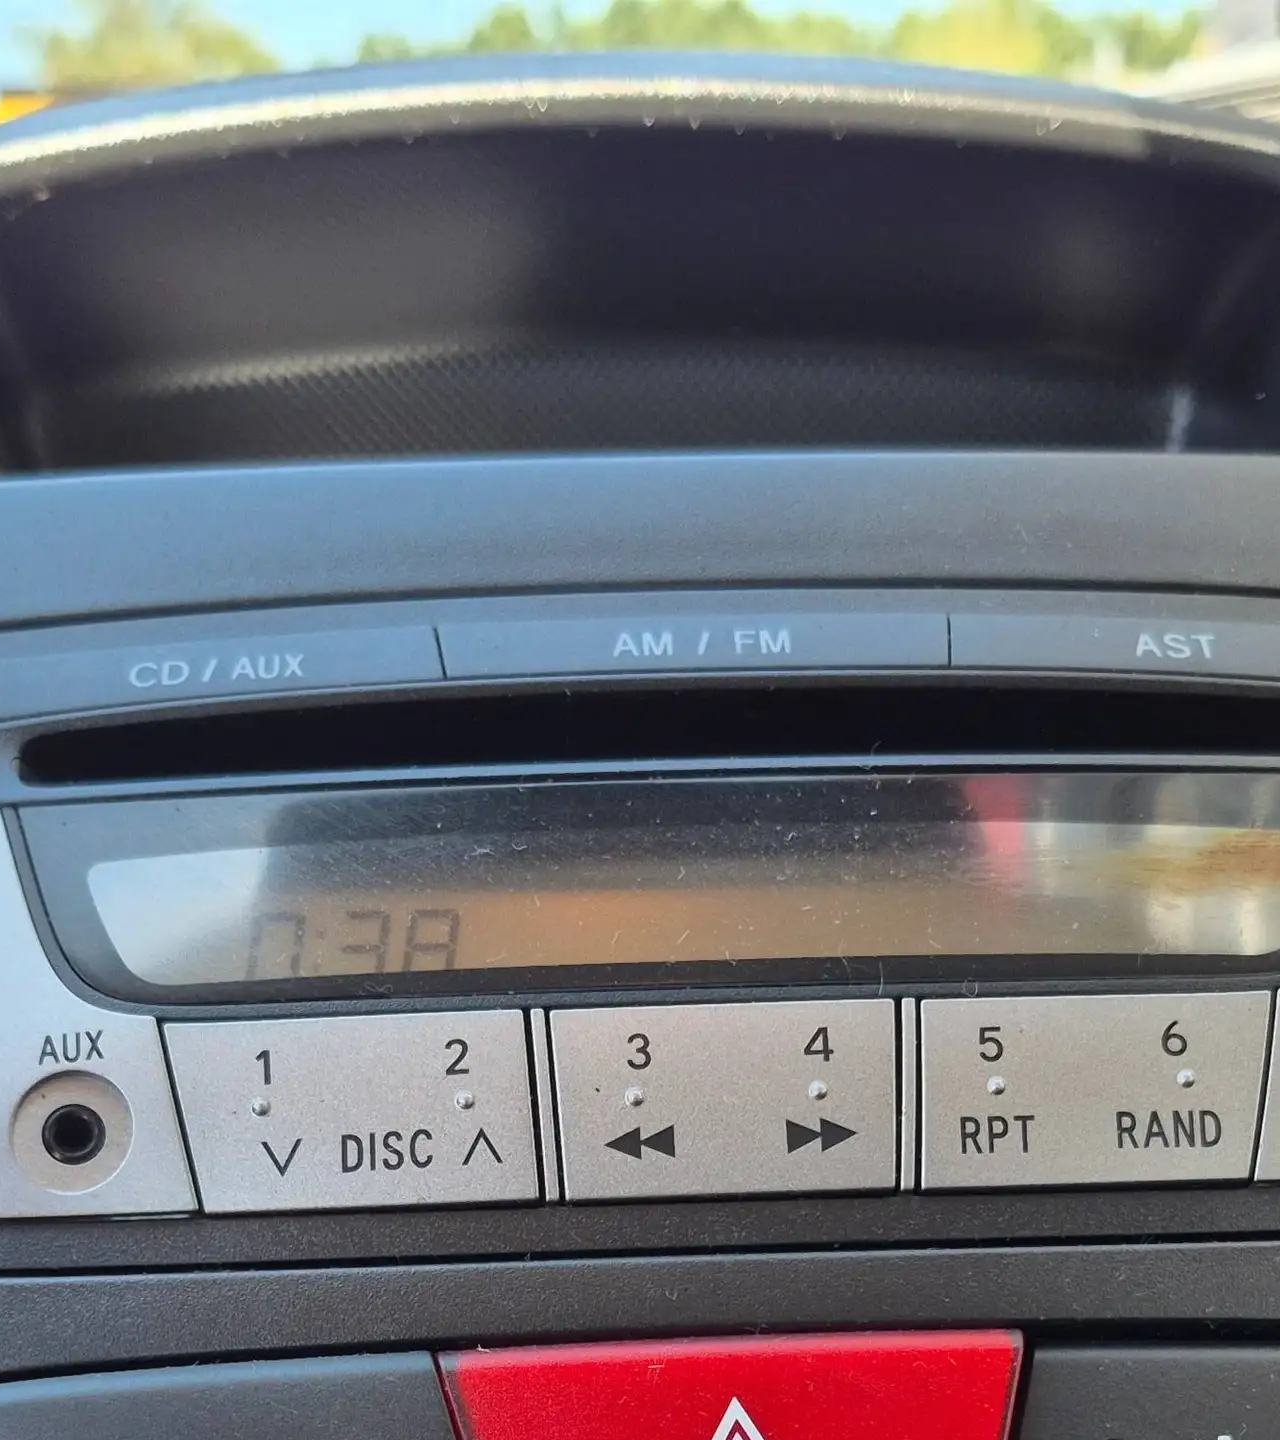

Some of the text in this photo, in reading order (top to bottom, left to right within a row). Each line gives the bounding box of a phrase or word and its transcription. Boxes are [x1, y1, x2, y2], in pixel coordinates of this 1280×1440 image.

[612, 631, 674, 658] AM
[732, 628, 792, 655] FM
[1135, 632, 1216, 659] AST
[128, 660, 190, 688] CD
[231, 653, 304, 681] AUX
[38, 1029, 105, 1066] AUX
[626, 1032, 652, 1070] 3
[803, 1026, 835, 1062] 4
[978, 1026, 1004, 1062] 5
[1161, 1019, 1188, 1057] 6
[255, 1049, 271, 1086] 1
[444, 1038, 470, 1076] 2
[959, 1114, 1036, 1155] RPT
[1115, 1109, 1223, 1149] RAND
[340, 1128, 434, 1173] DISC
